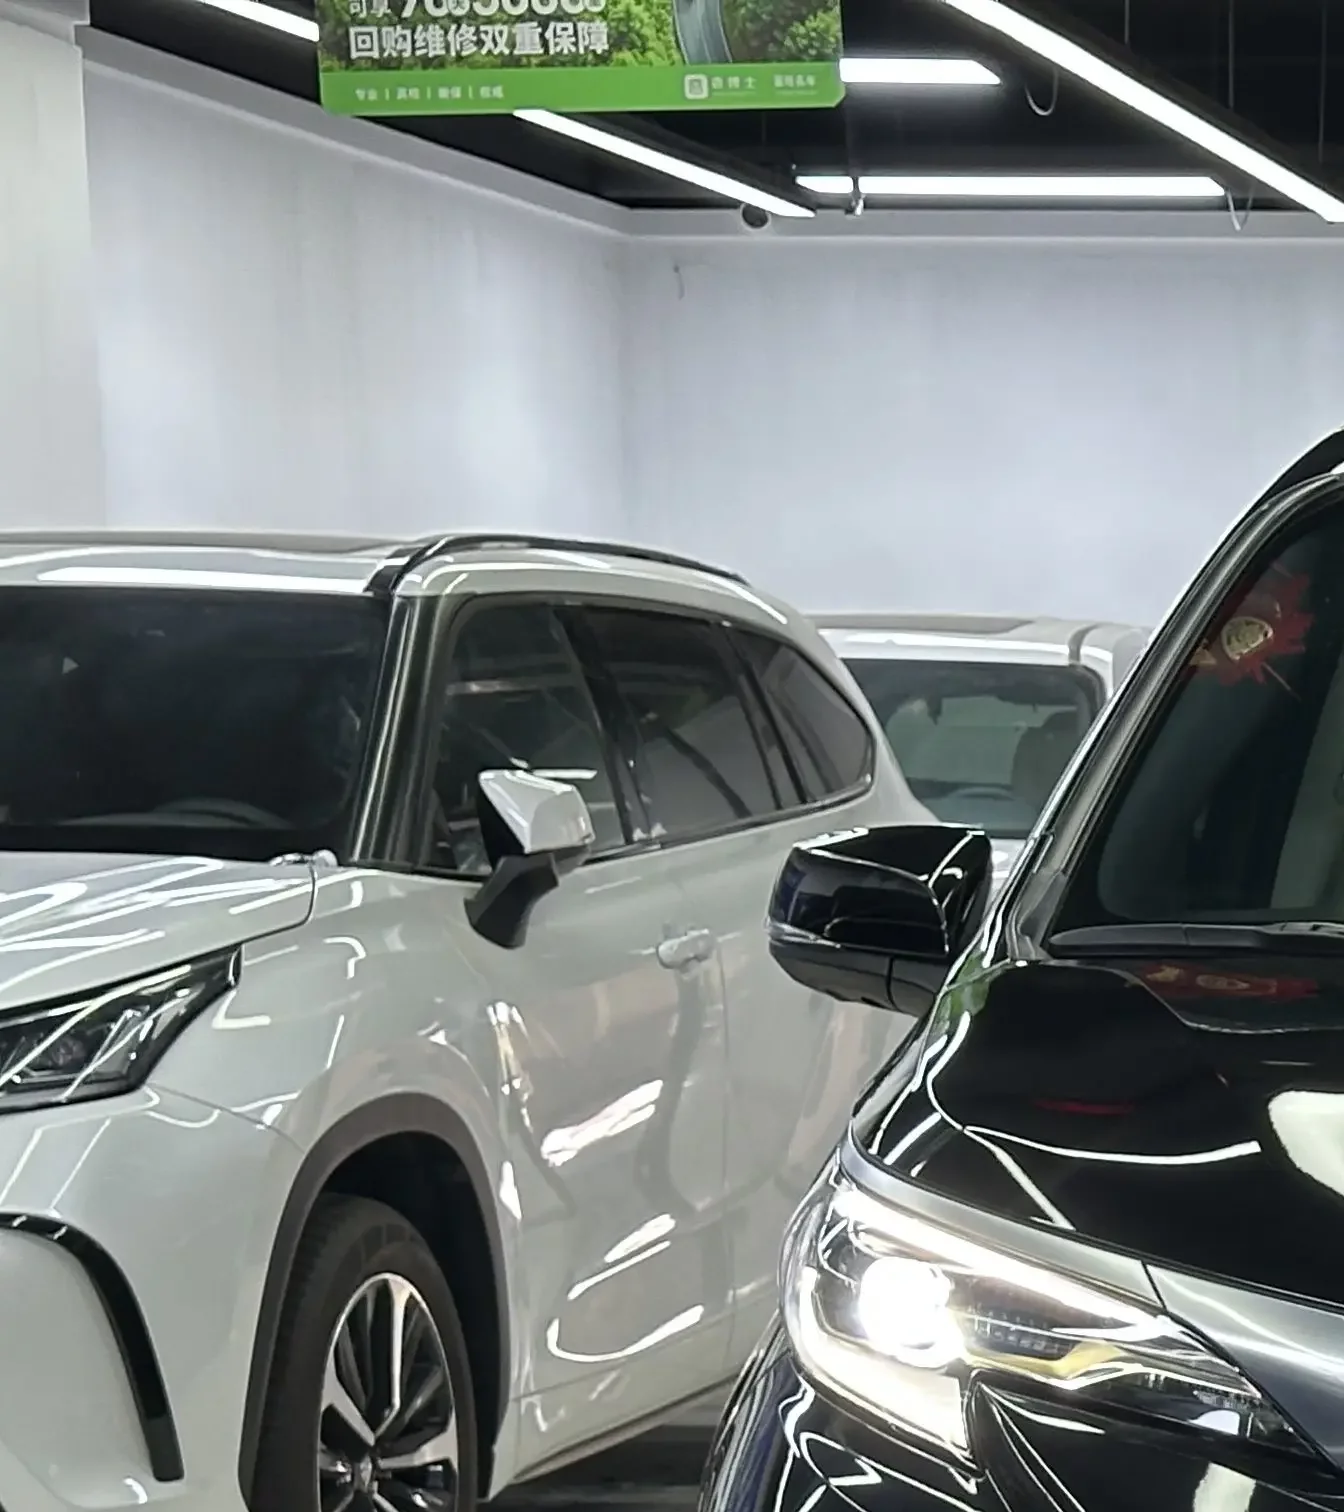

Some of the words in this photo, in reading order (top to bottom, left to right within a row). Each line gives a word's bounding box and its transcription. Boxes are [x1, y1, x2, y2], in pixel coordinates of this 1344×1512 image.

[349, 21, 610, 59] 回购维修双重保障
